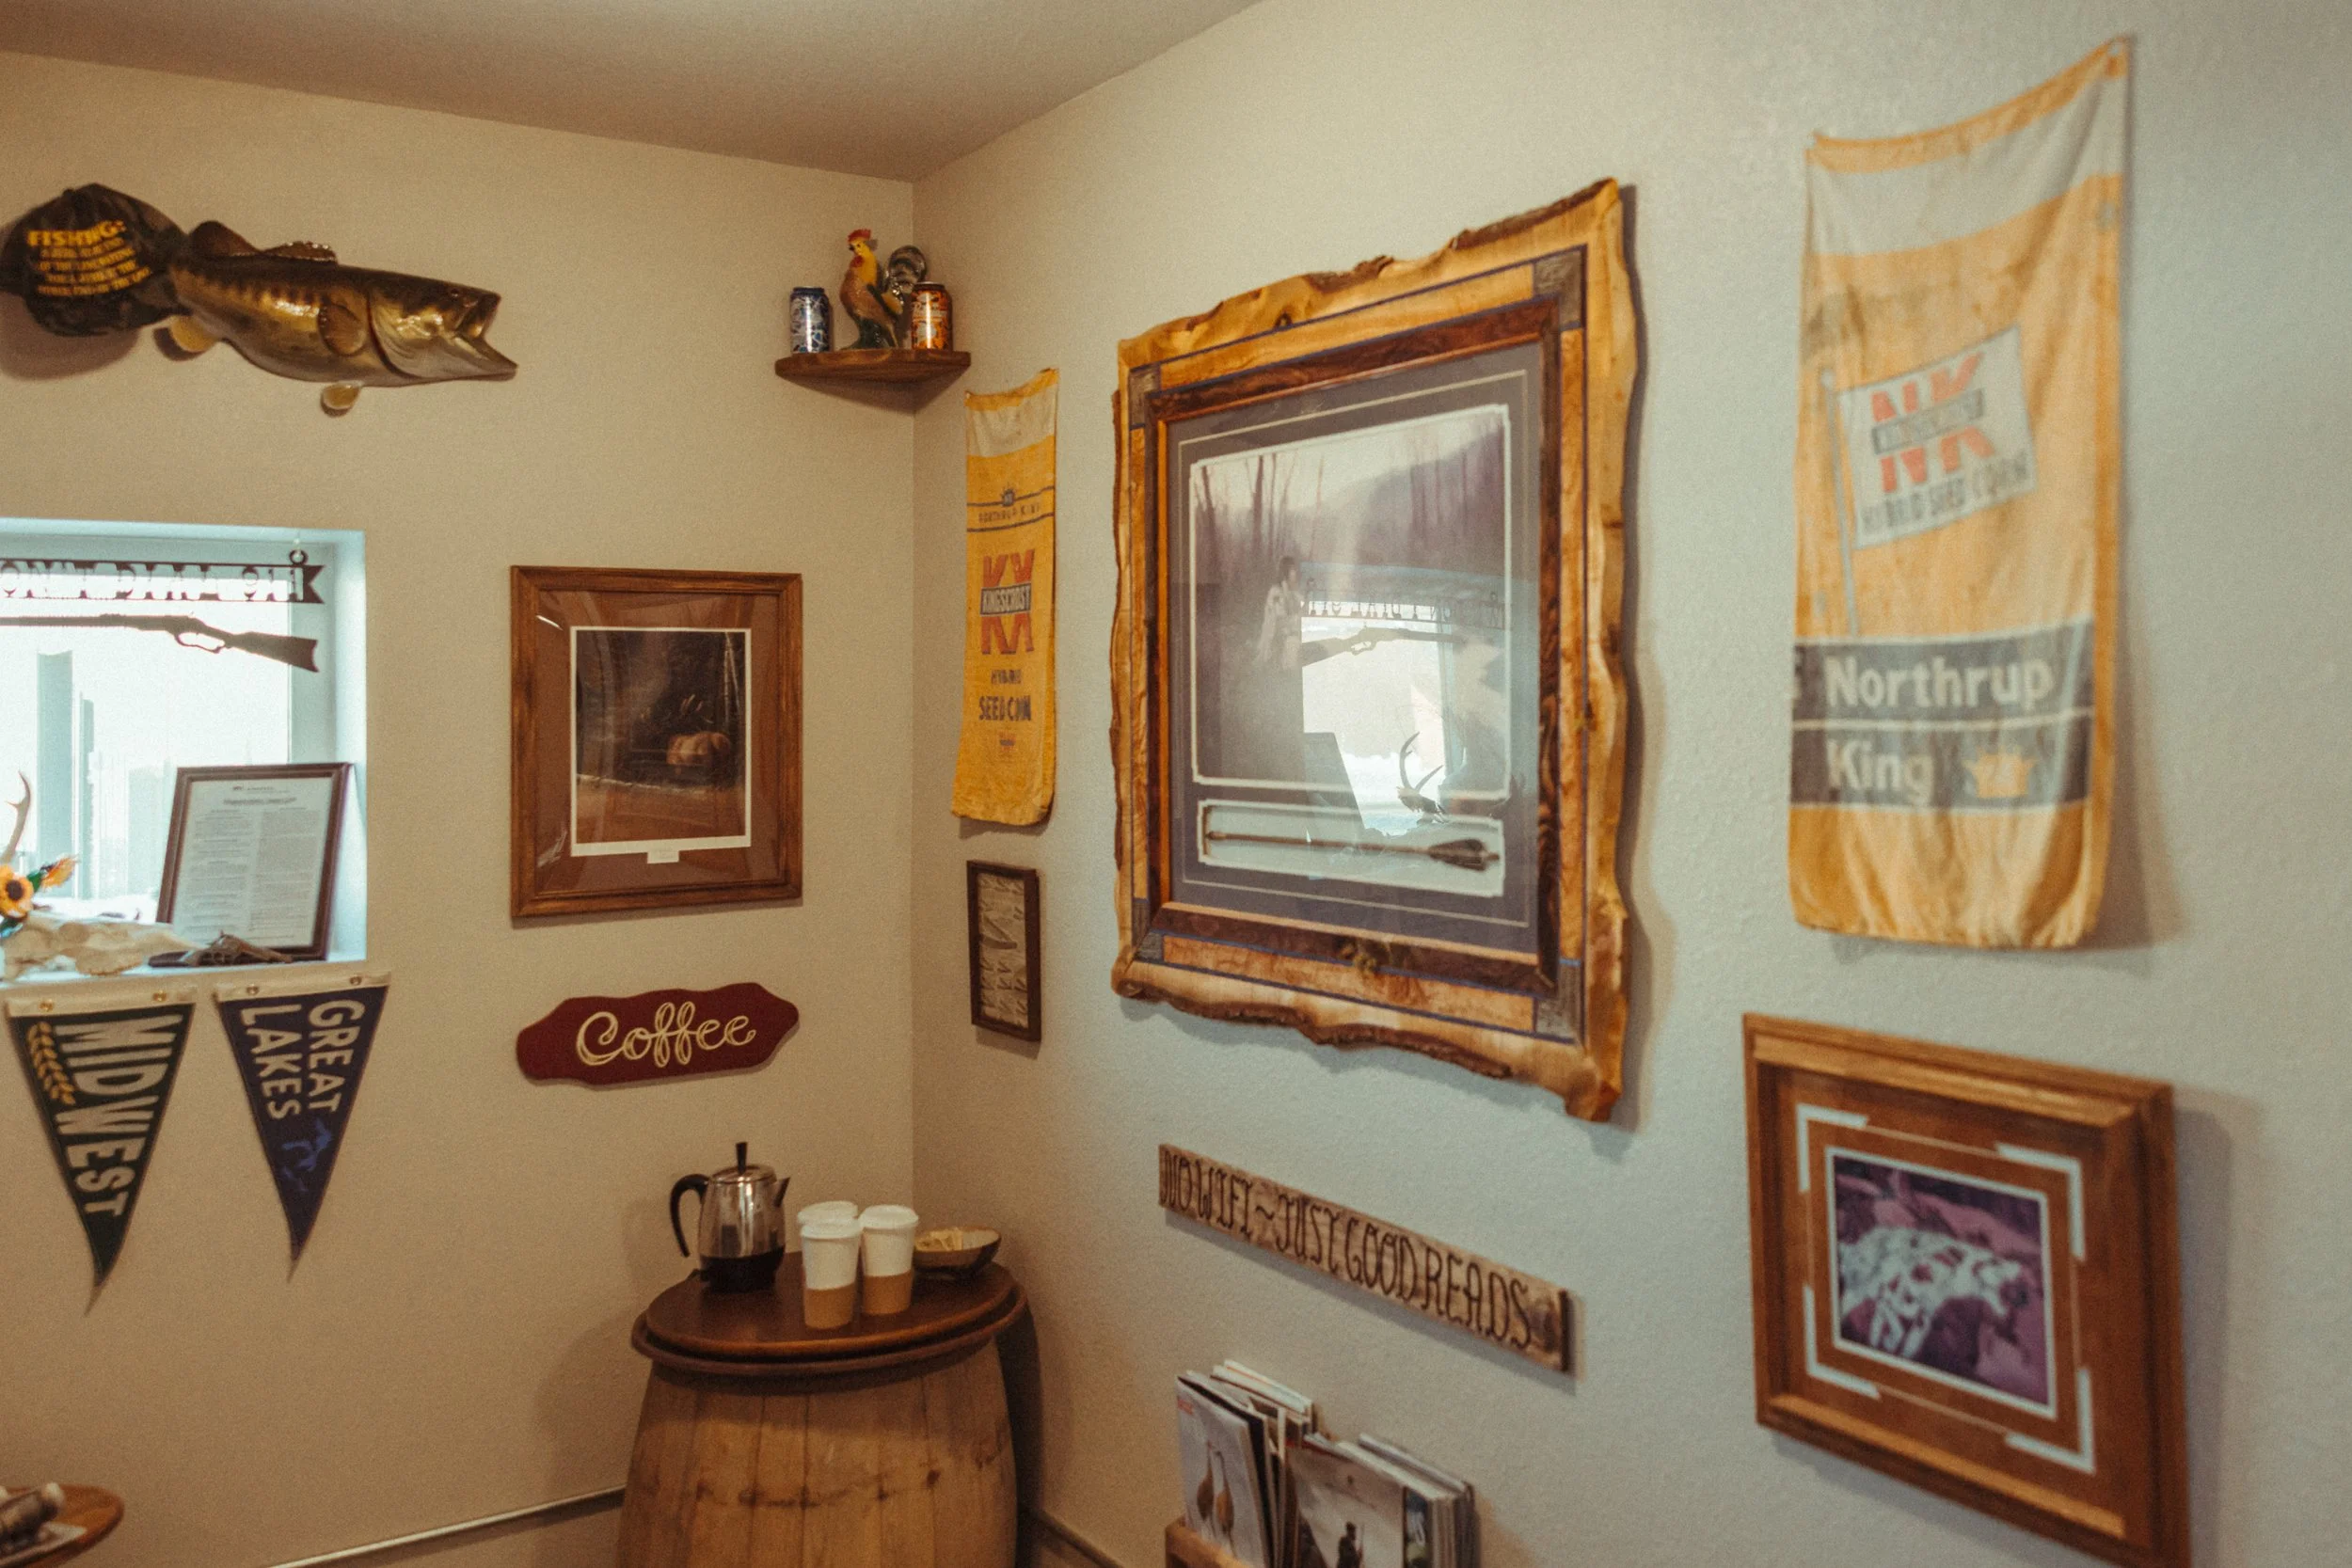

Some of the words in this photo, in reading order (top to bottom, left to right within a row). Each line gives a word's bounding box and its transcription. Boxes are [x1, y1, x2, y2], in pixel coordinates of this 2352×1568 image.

[1823, 655, 2055, 710] Northrup
[1824, 738, 1934, 806] King
[240, 1003, 303, 1120] LAKES
[307, 998, 366, 1114] GREAT
[576, 1000, 756, 1069] Coffee
[54, 1013, 184, 1217] MIDWEST
[1160, 1149, 1193, 1212] NO
[1195, 1157, 1253, 1240] WIFI
[1275, 1193, 1341, 1276] JUST
[1345, 1216, 1418, 1302] GOOD
[1421, 1244, 1532, 1350] READS
